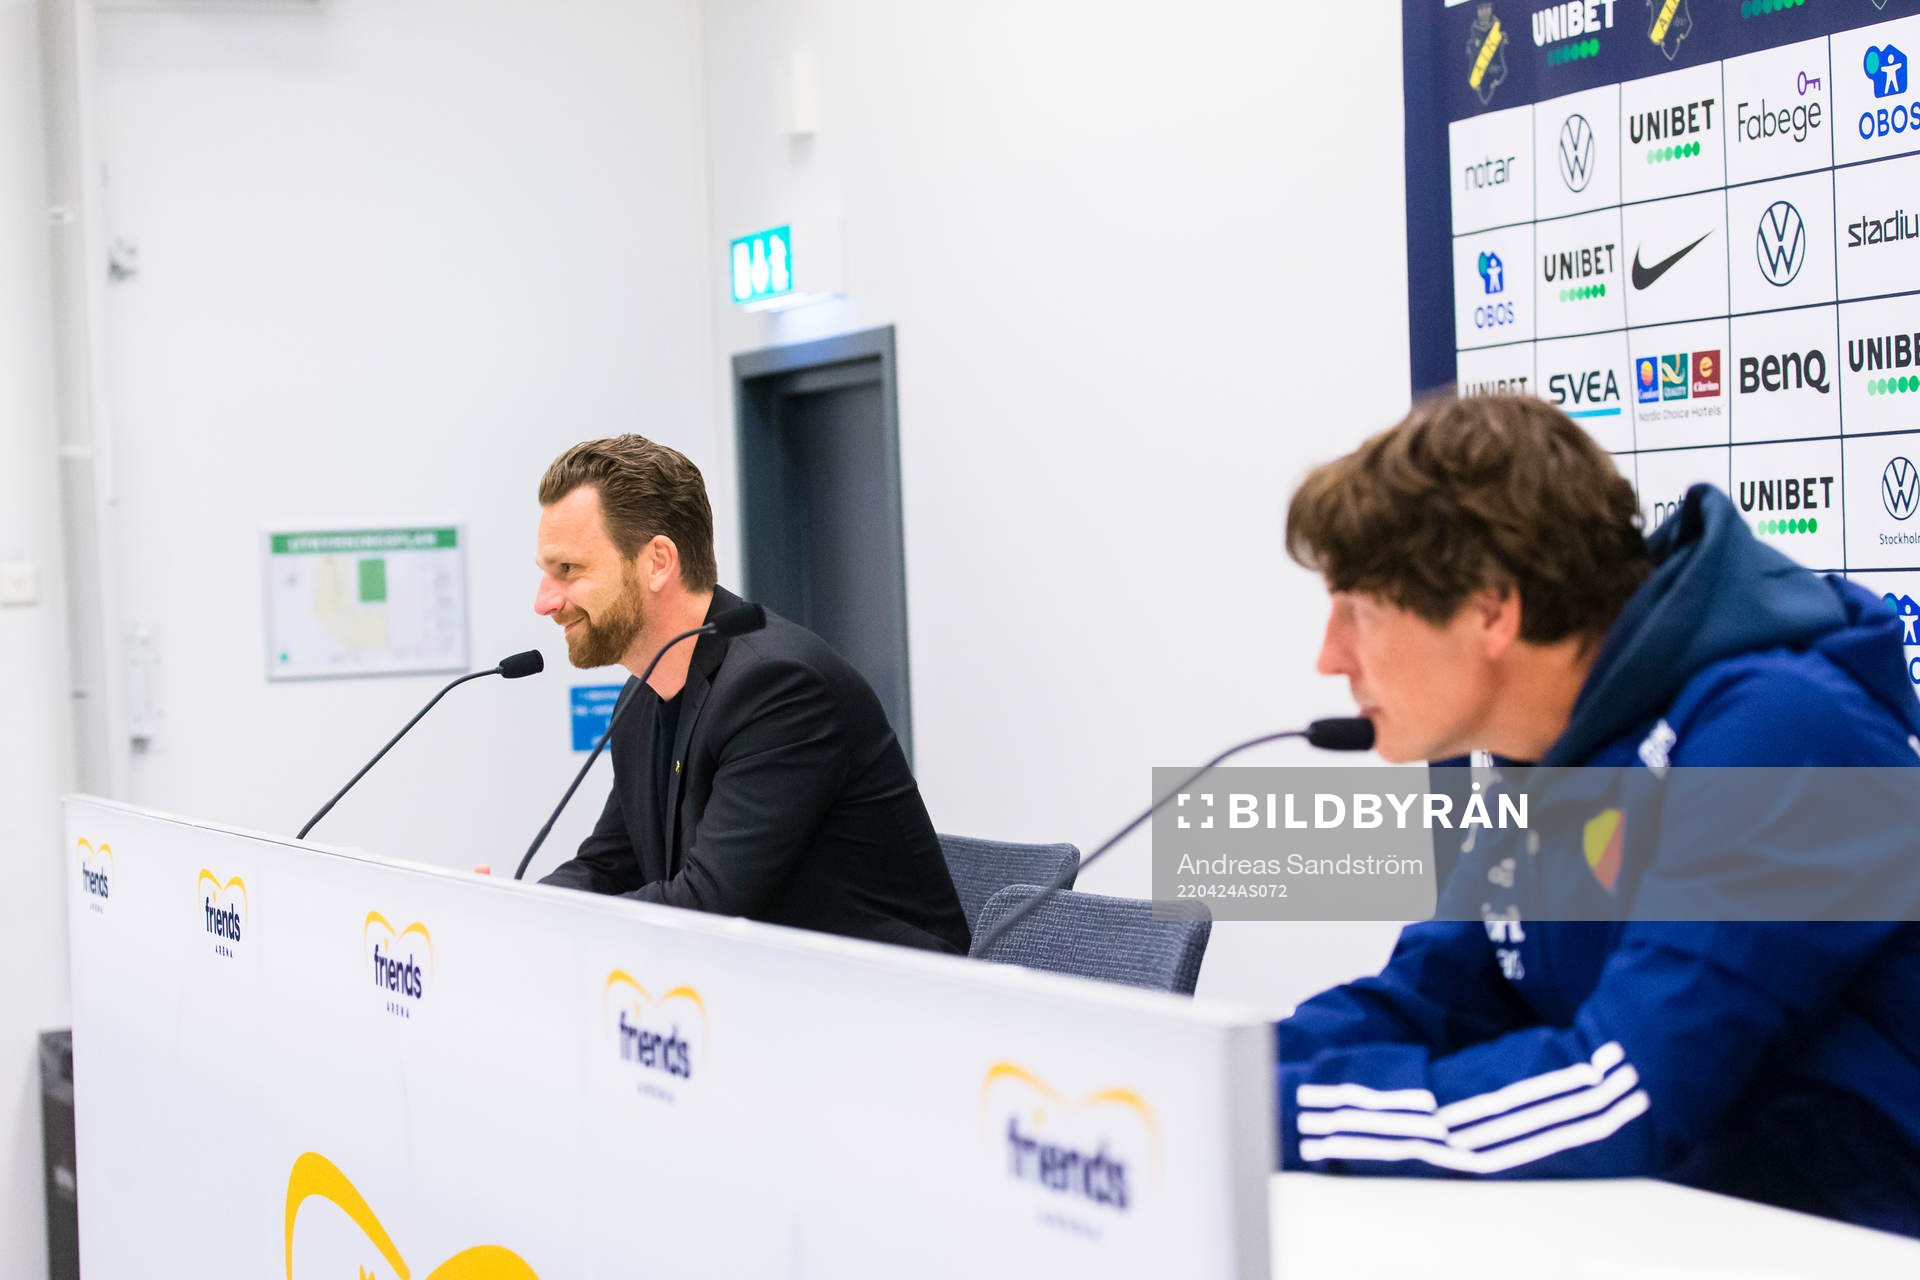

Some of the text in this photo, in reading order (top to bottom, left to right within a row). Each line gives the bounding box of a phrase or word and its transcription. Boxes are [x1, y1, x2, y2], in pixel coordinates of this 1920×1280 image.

[1532, 0, 1615, 47] UNIBET
[1630, 99, 1715, 144] UNIBET
[1738, 98, 1821, 143] Fabege
[1859, 101, 1920, 140] OBOS
[1465, 154, 1516, 191] notar
[1544, 243, 1615, 283] UNIBET
[1474, 303, 1515, 329] OBOS
[1550, 369, 1620, 404] SVEA
[1740, 349, 1831, 395] BenQ
[1740, 476, 1834, 512] UNIBET
[82, 860, 109, 899] friends
[205, 892, 241, 942] friends
[374, 940, 423, 999] friends
